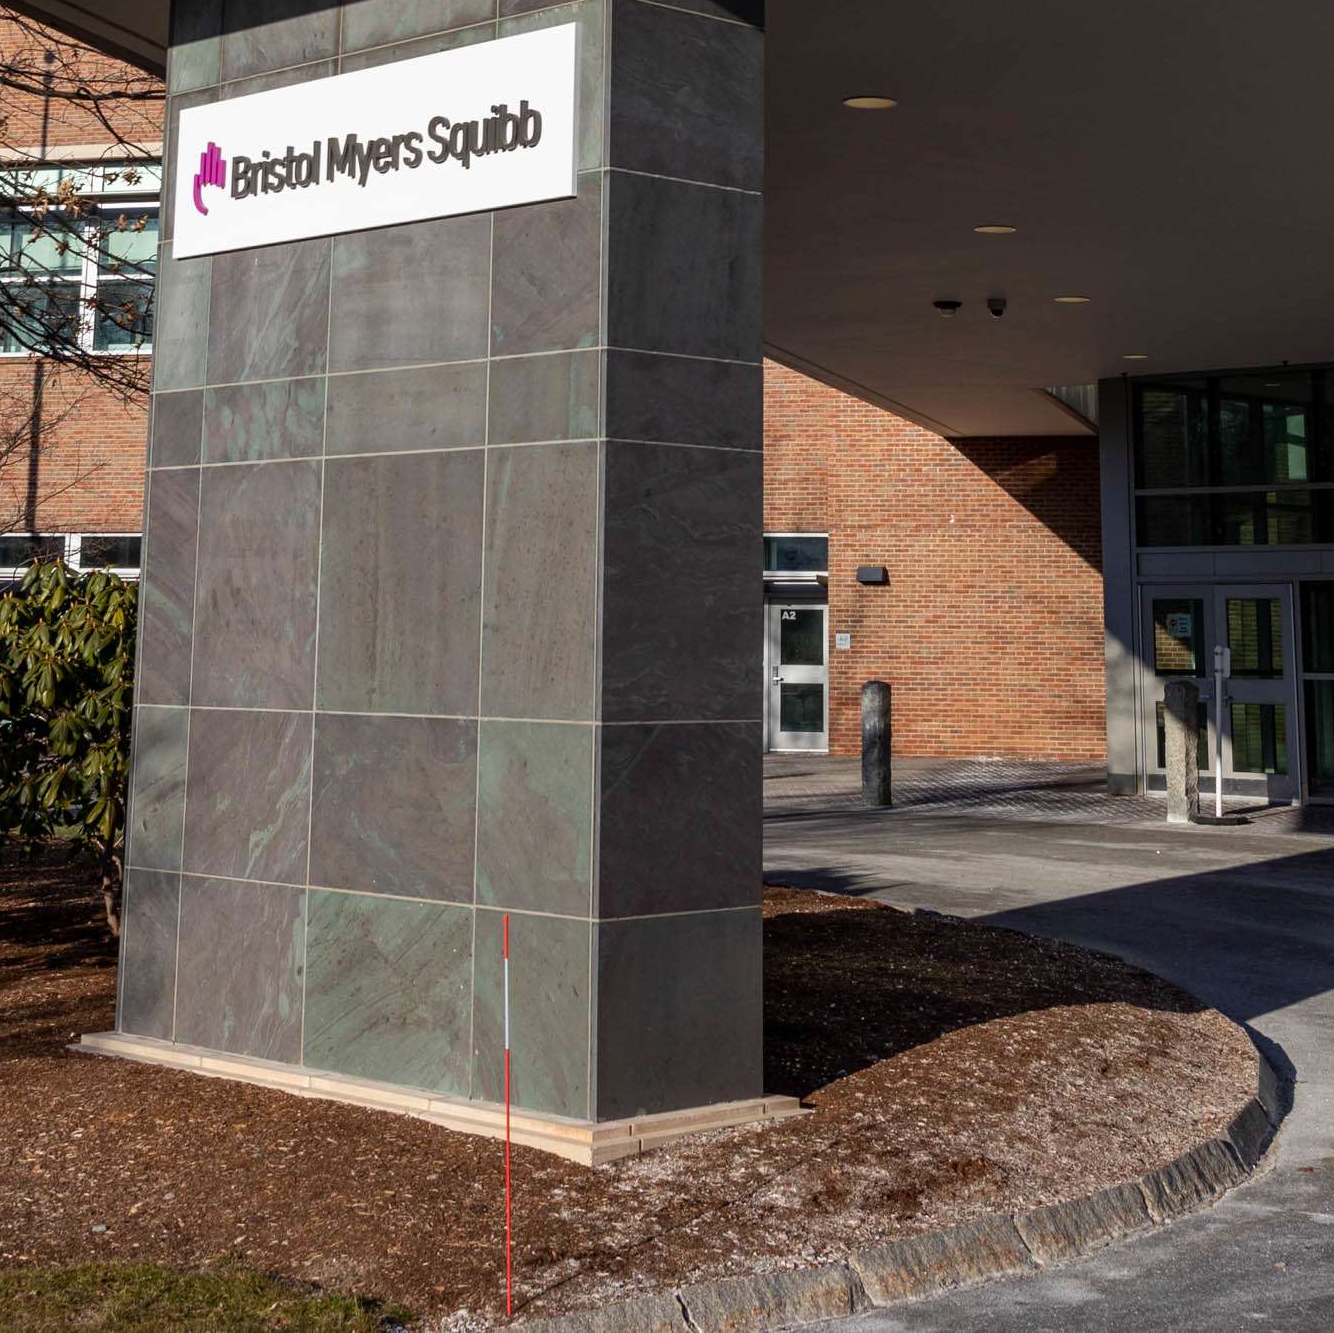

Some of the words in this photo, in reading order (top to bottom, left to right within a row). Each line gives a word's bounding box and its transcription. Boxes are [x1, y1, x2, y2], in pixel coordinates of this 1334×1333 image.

[230, 140, 322, 200] Bristol
[326, 131, 423, 187] Myers
[427, 100, 542, 169] Squibb
[781, 611, 796, 620] A2
